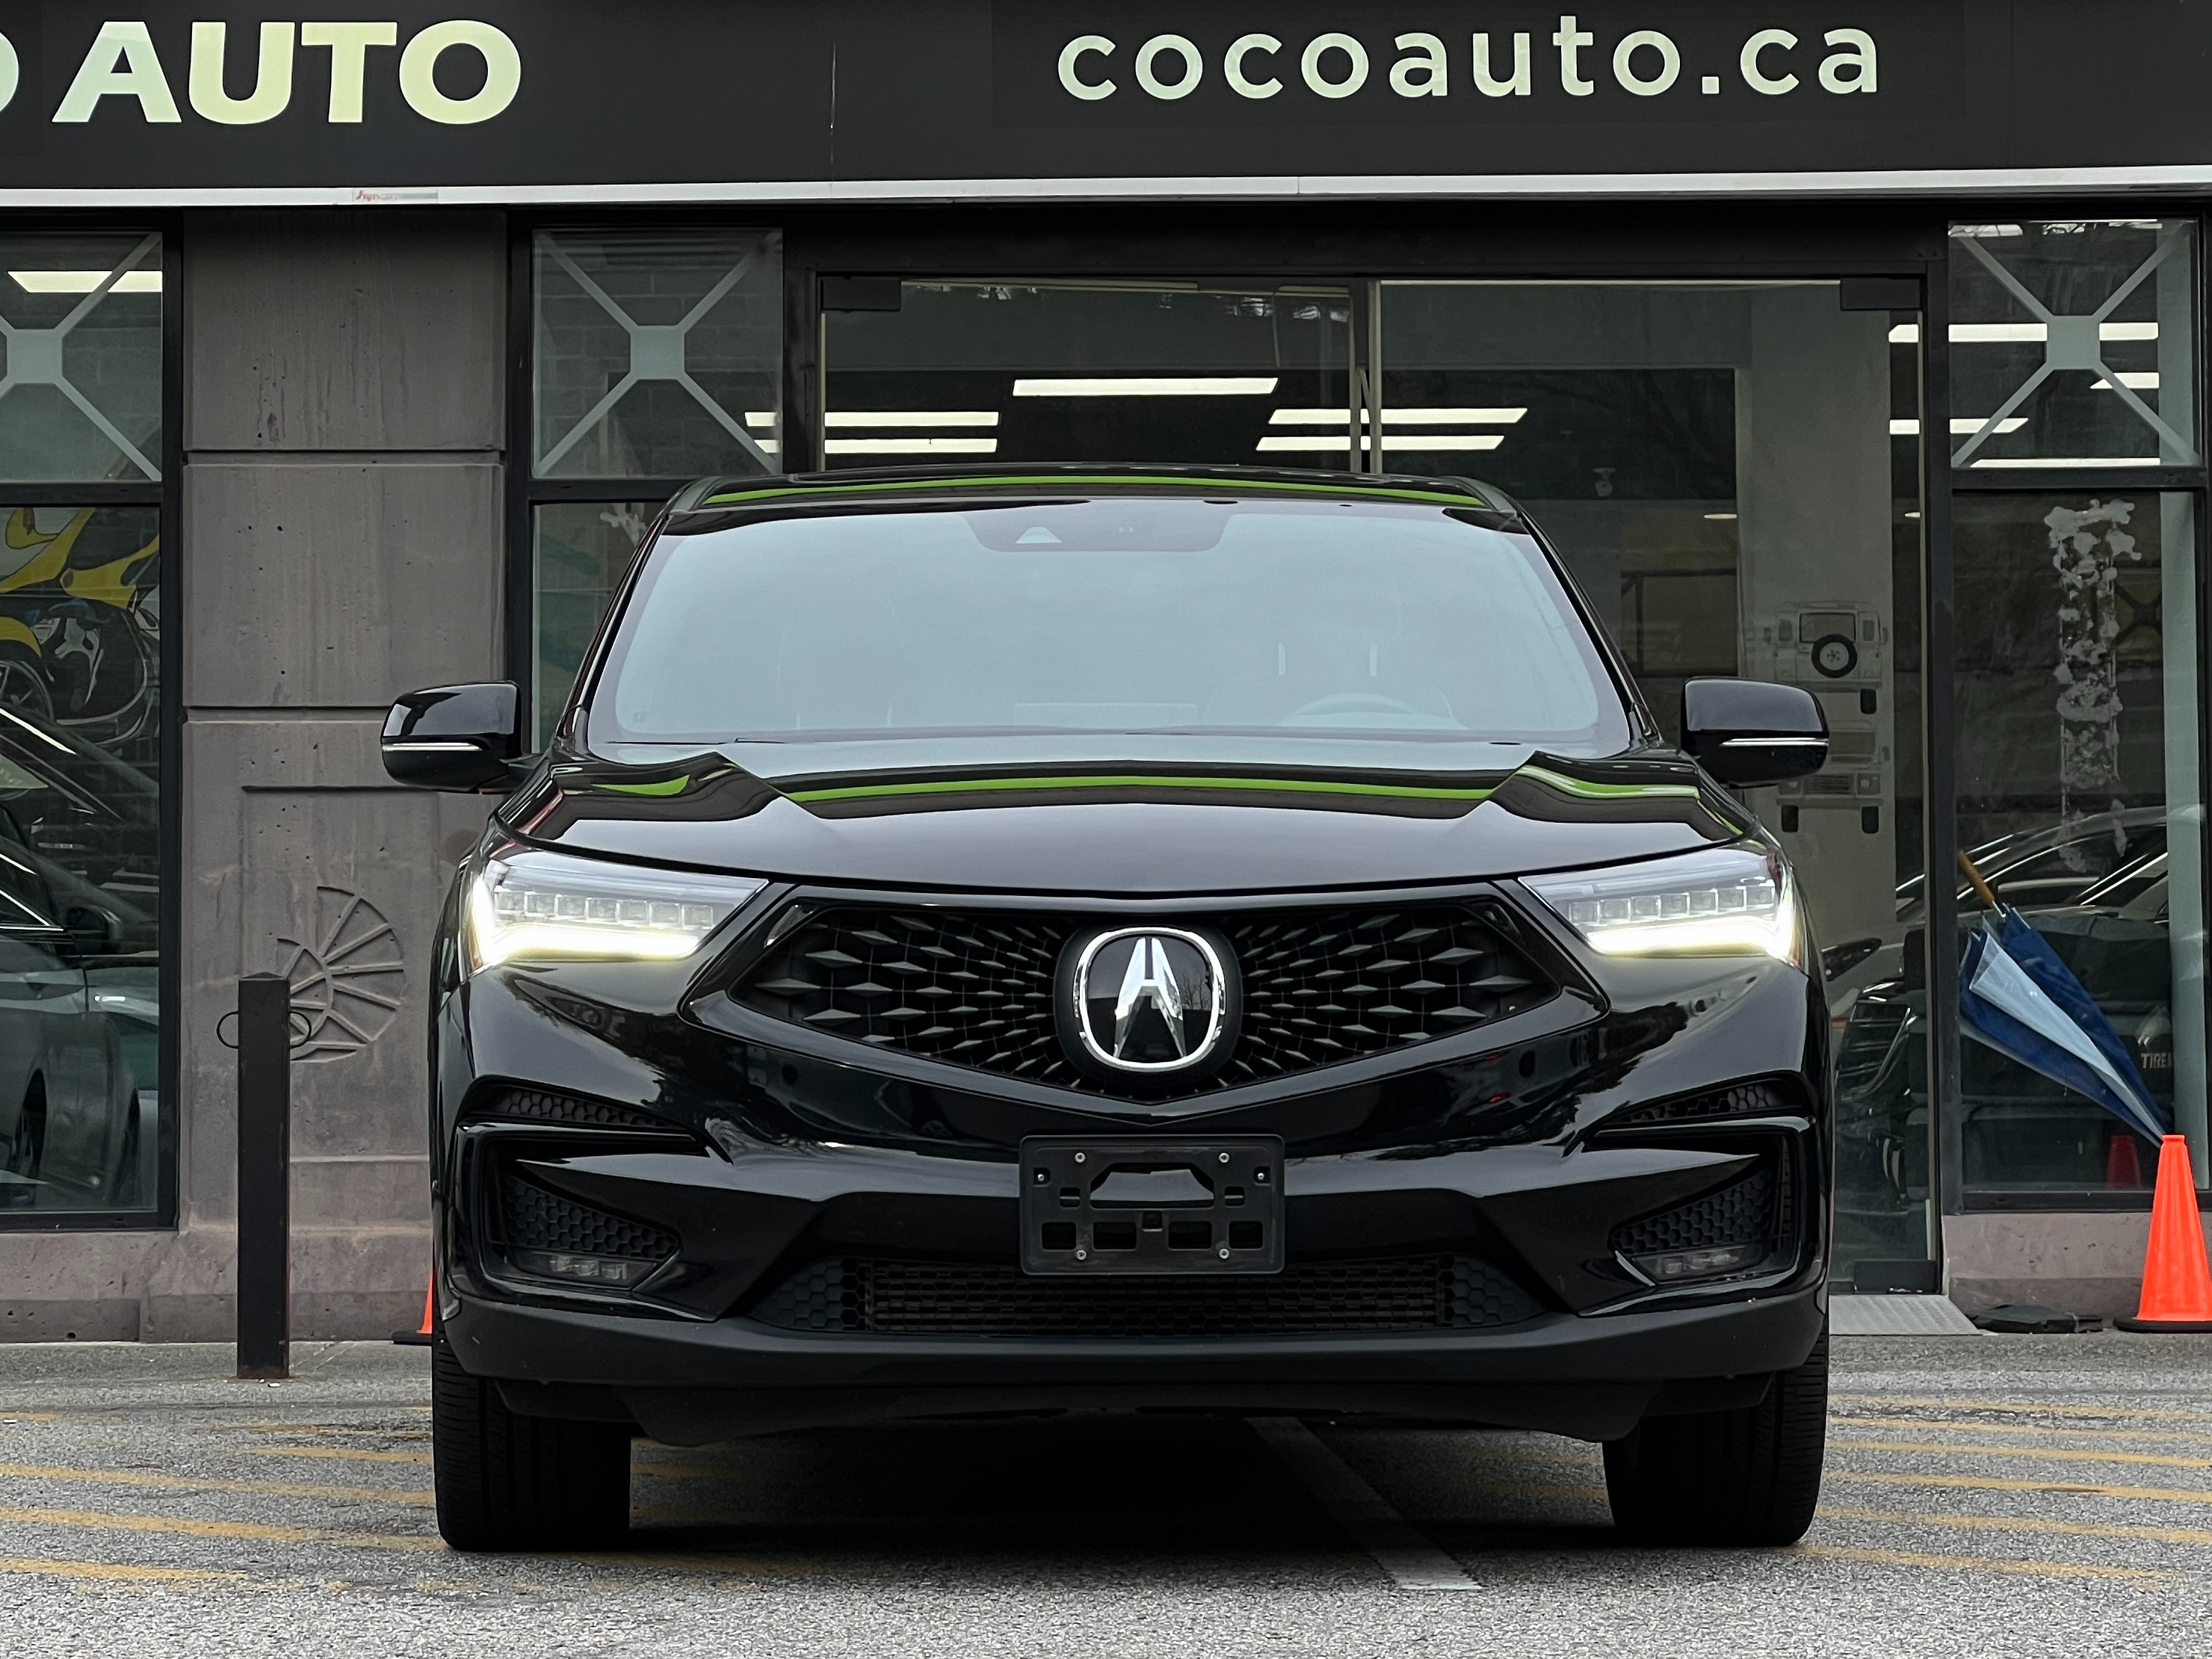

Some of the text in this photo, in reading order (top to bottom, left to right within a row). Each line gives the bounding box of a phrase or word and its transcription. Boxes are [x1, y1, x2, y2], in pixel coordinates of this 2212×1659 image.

[52, 19, 522, 125] AUTO
[1057, 15, 1878, 101] cocoauto.ca
[2141, 1052, 2172, 1069] TIRE
